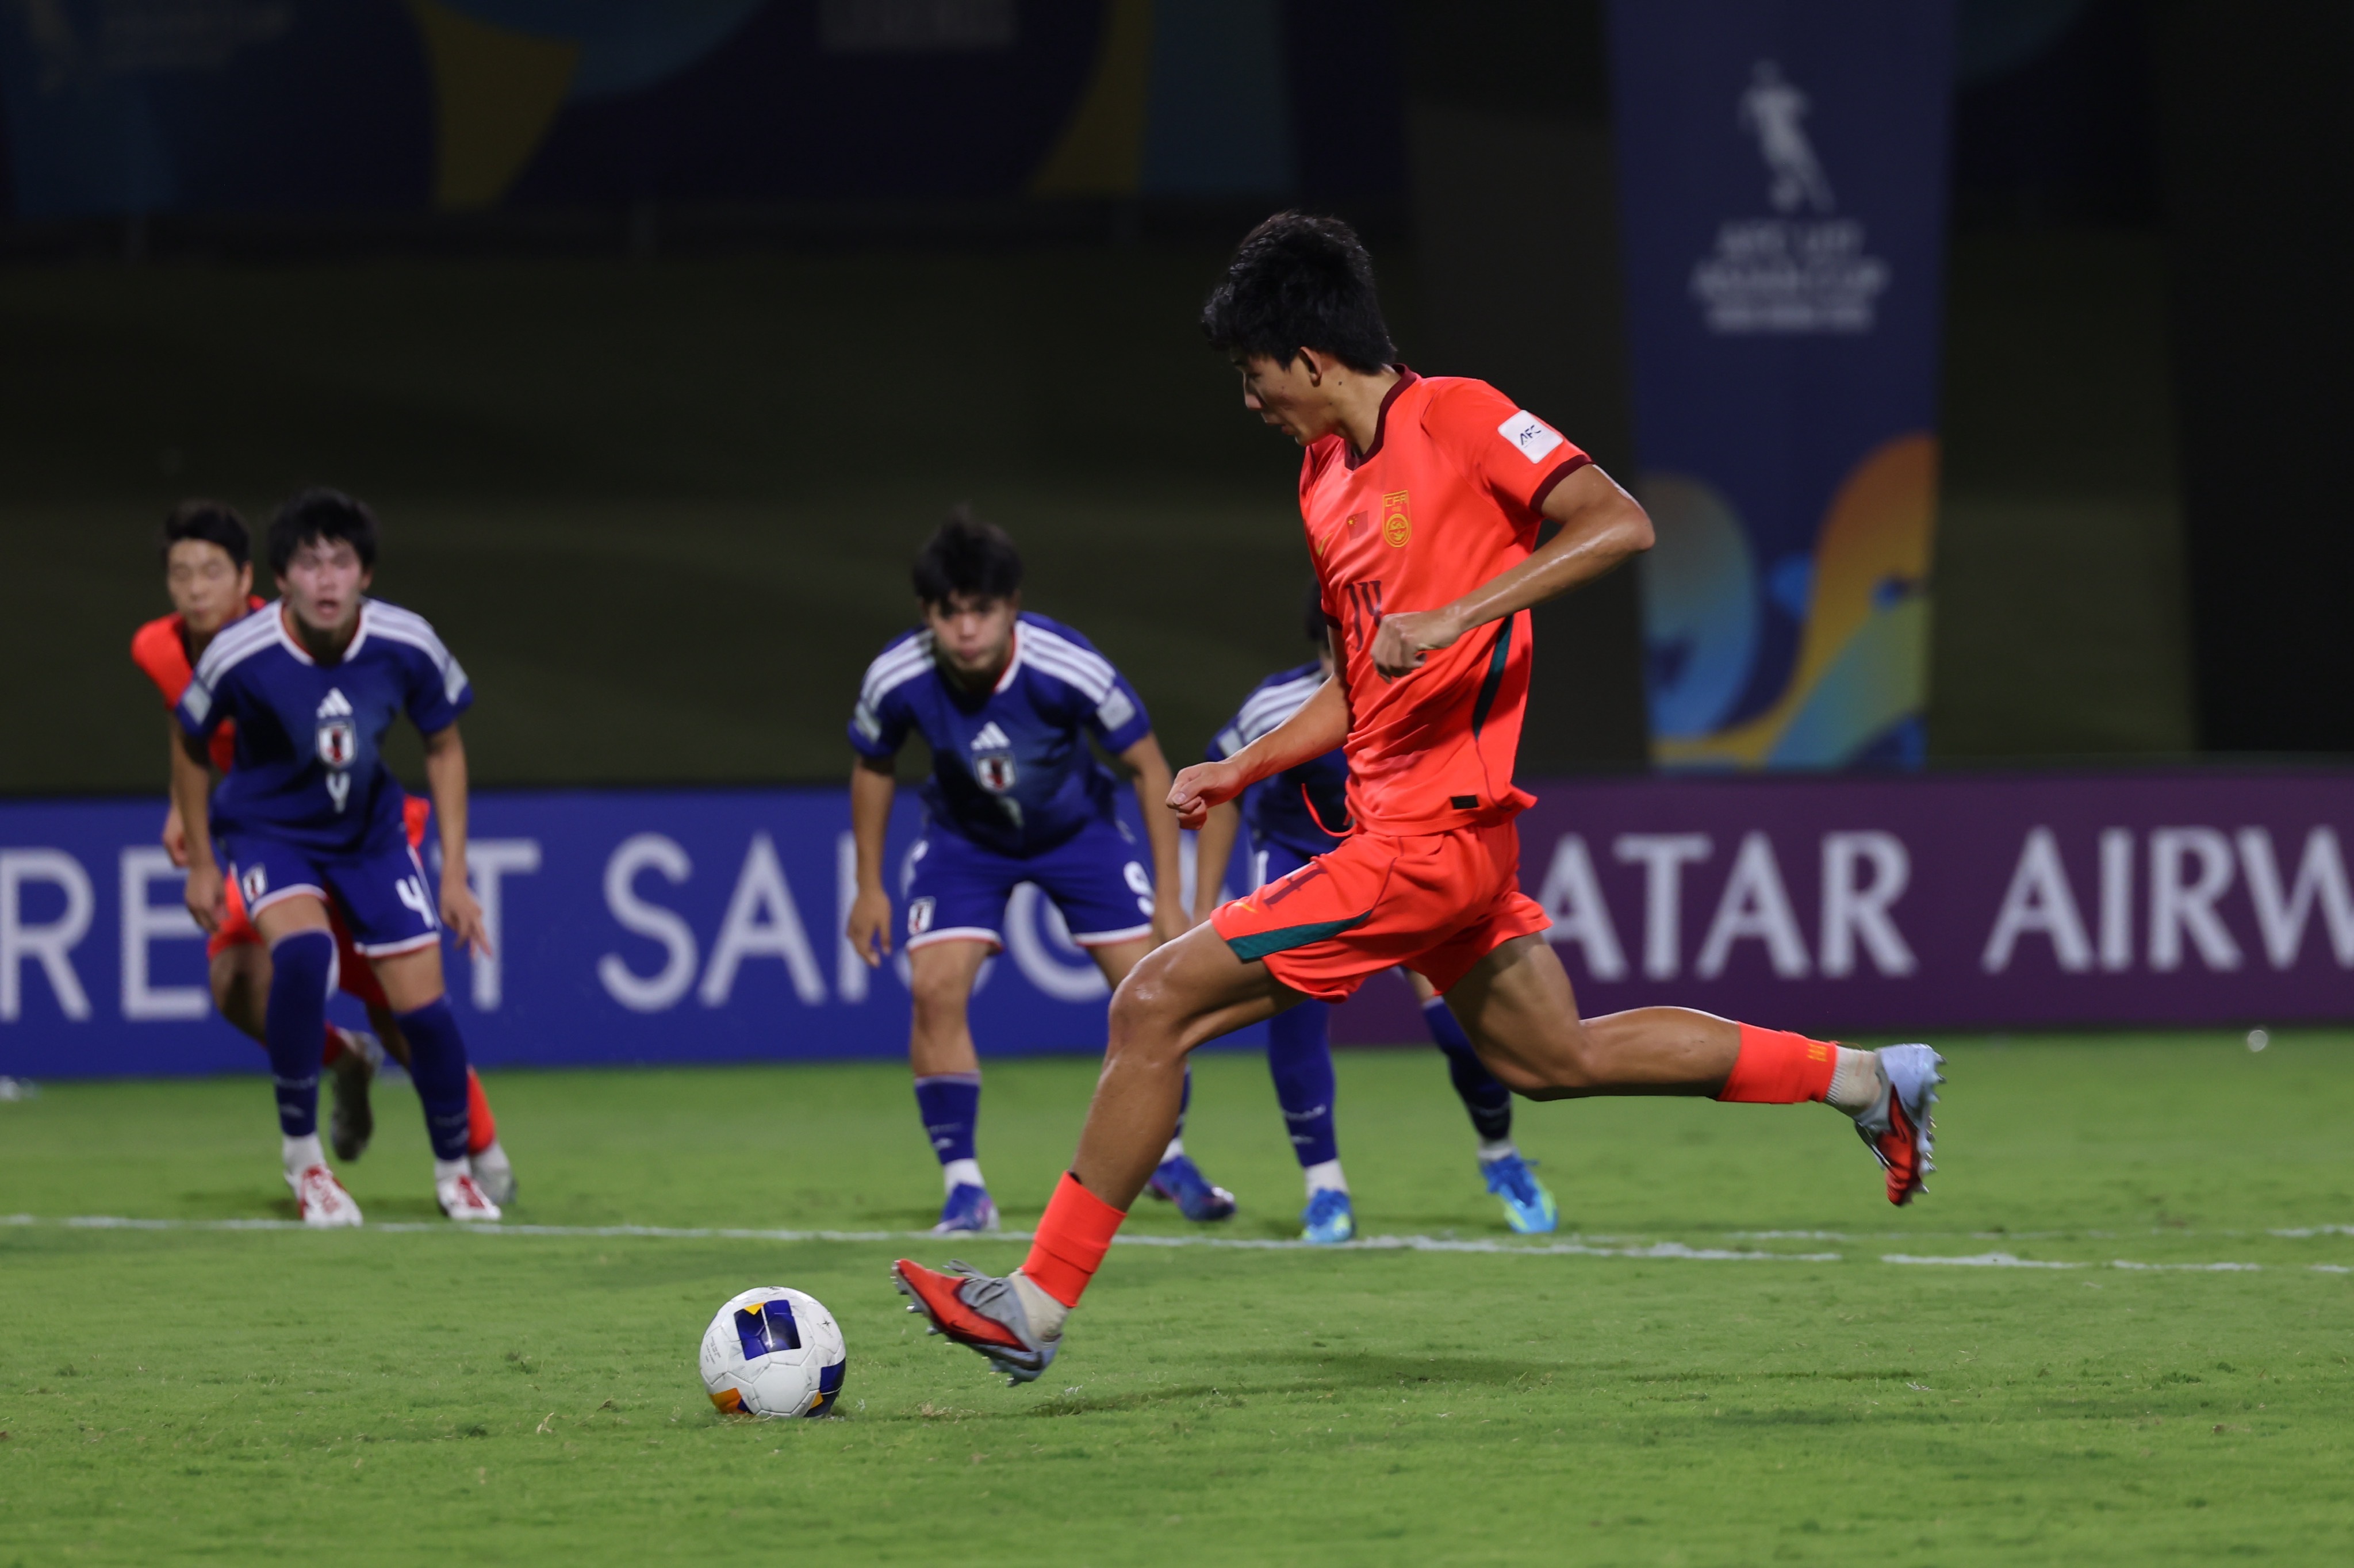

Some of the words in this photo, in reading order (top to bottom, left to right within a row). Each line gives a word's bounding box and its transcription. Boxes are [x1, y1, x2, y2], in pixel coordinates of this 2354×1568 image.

[1520, 424, 1542, 446] AFC
[395, 874, 434, 929] 4
[1534, 831, 1918, 981] ATAR
